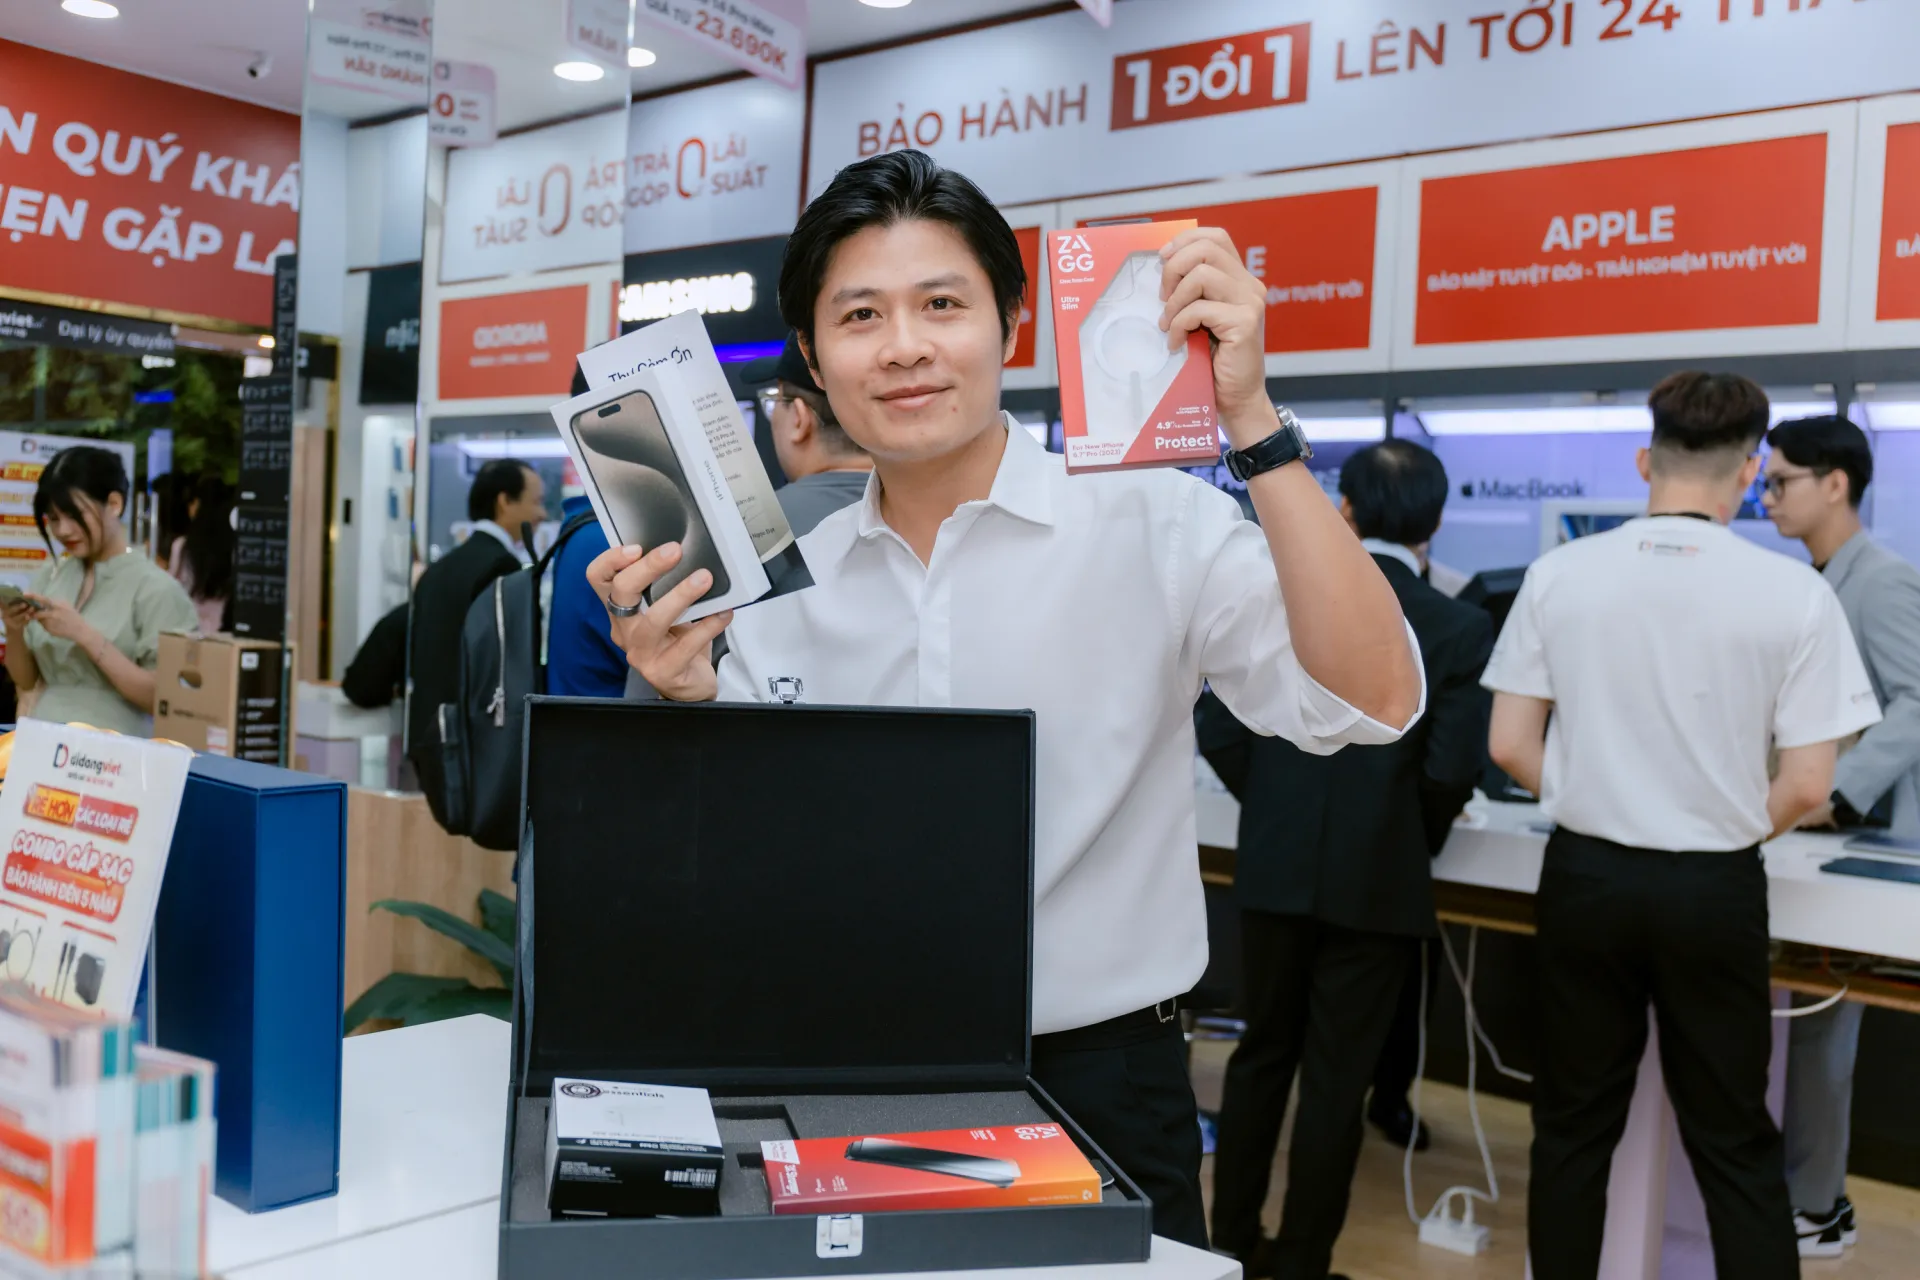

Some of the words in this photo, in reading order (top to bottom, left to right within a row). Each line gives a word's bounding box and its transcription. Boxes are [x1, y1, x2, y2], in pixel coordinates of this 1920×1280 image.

[1335, 20, 1447, 81] LÊN
[1599, 0, 1681, 41] 24
[1126, 59, 1152, 121] 1
[1164, 43, 1252, 107] ĐỔI
[1264, 34, 1293, 101] 1
[53, 121, 184, 183] QUÝ
[858, 102, 944, 157] BẢO
[959, 85, 1088, 141] HÀNH
[676, 136, 706, 199] 0
[0, 184, 89, 243] ẸN
[103, 204, 223, 268] GẶP
[1541, 204, 1676, 253] APPLE
[1155, 433, 1213, 450] Protect
[1478, 477, 1587, 499] MacBook
[12, 830, 67, 865] COMBO
[66, 840, 101, 874] CÁP
[99, 853, 135, 887] SẠC
